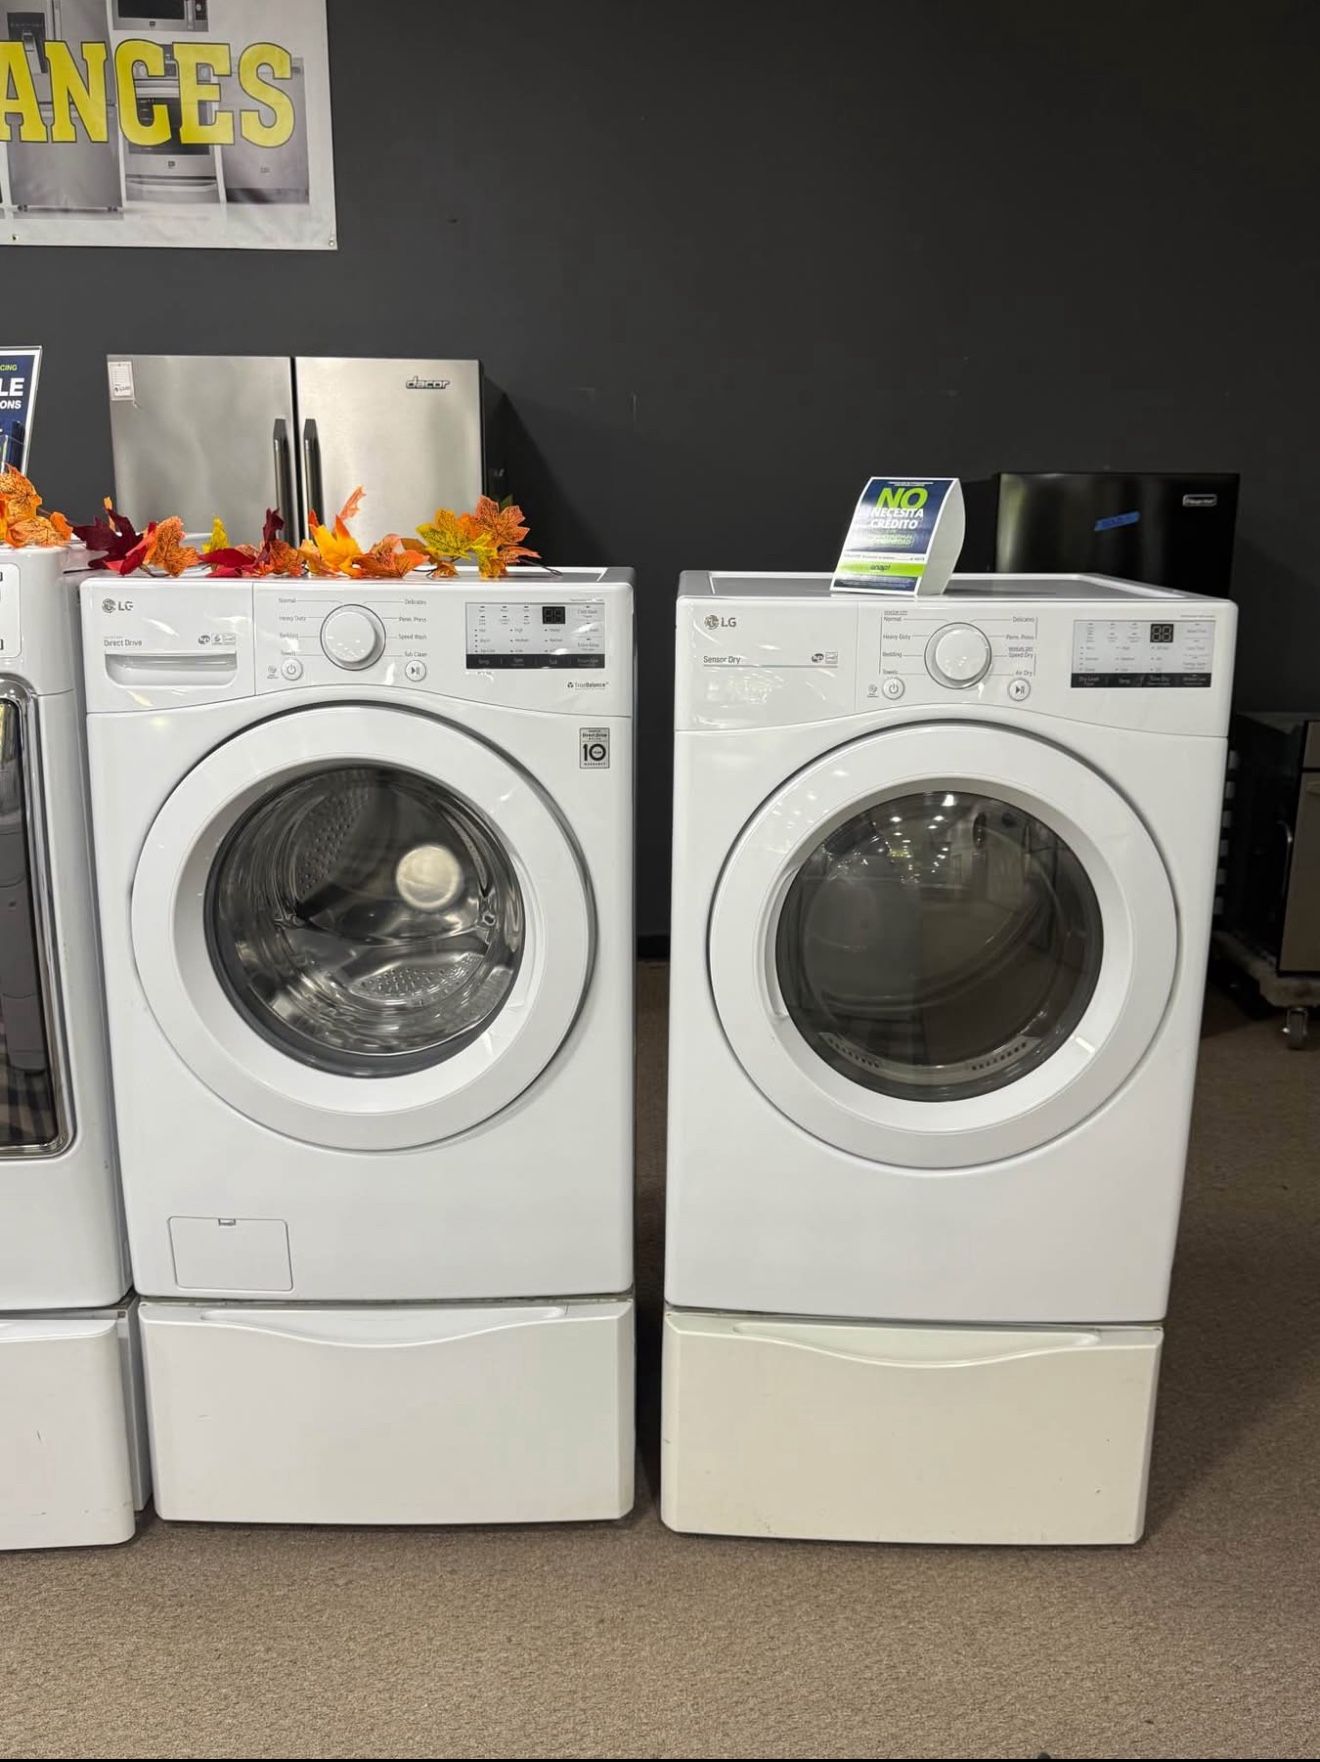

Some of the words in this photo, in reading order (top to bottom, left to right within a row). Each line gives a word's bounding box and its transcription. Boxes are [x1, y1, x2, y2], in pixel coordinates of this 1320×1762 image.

[406, 376, 450, 389] dacor
[874, 486, 928, 510] NO
[870, 507, 924, 518] NECESITA
[118, 601, 134, 611] LG
[721, 617, 737, 628] LG
[104, 639, 124, 647] Direct
[124, 639, 143, 647] Drive
[703, 655, 727, 664] Sensor
[728, 655, 741, 665] Dry
[583, 744, 606, 761] 10
